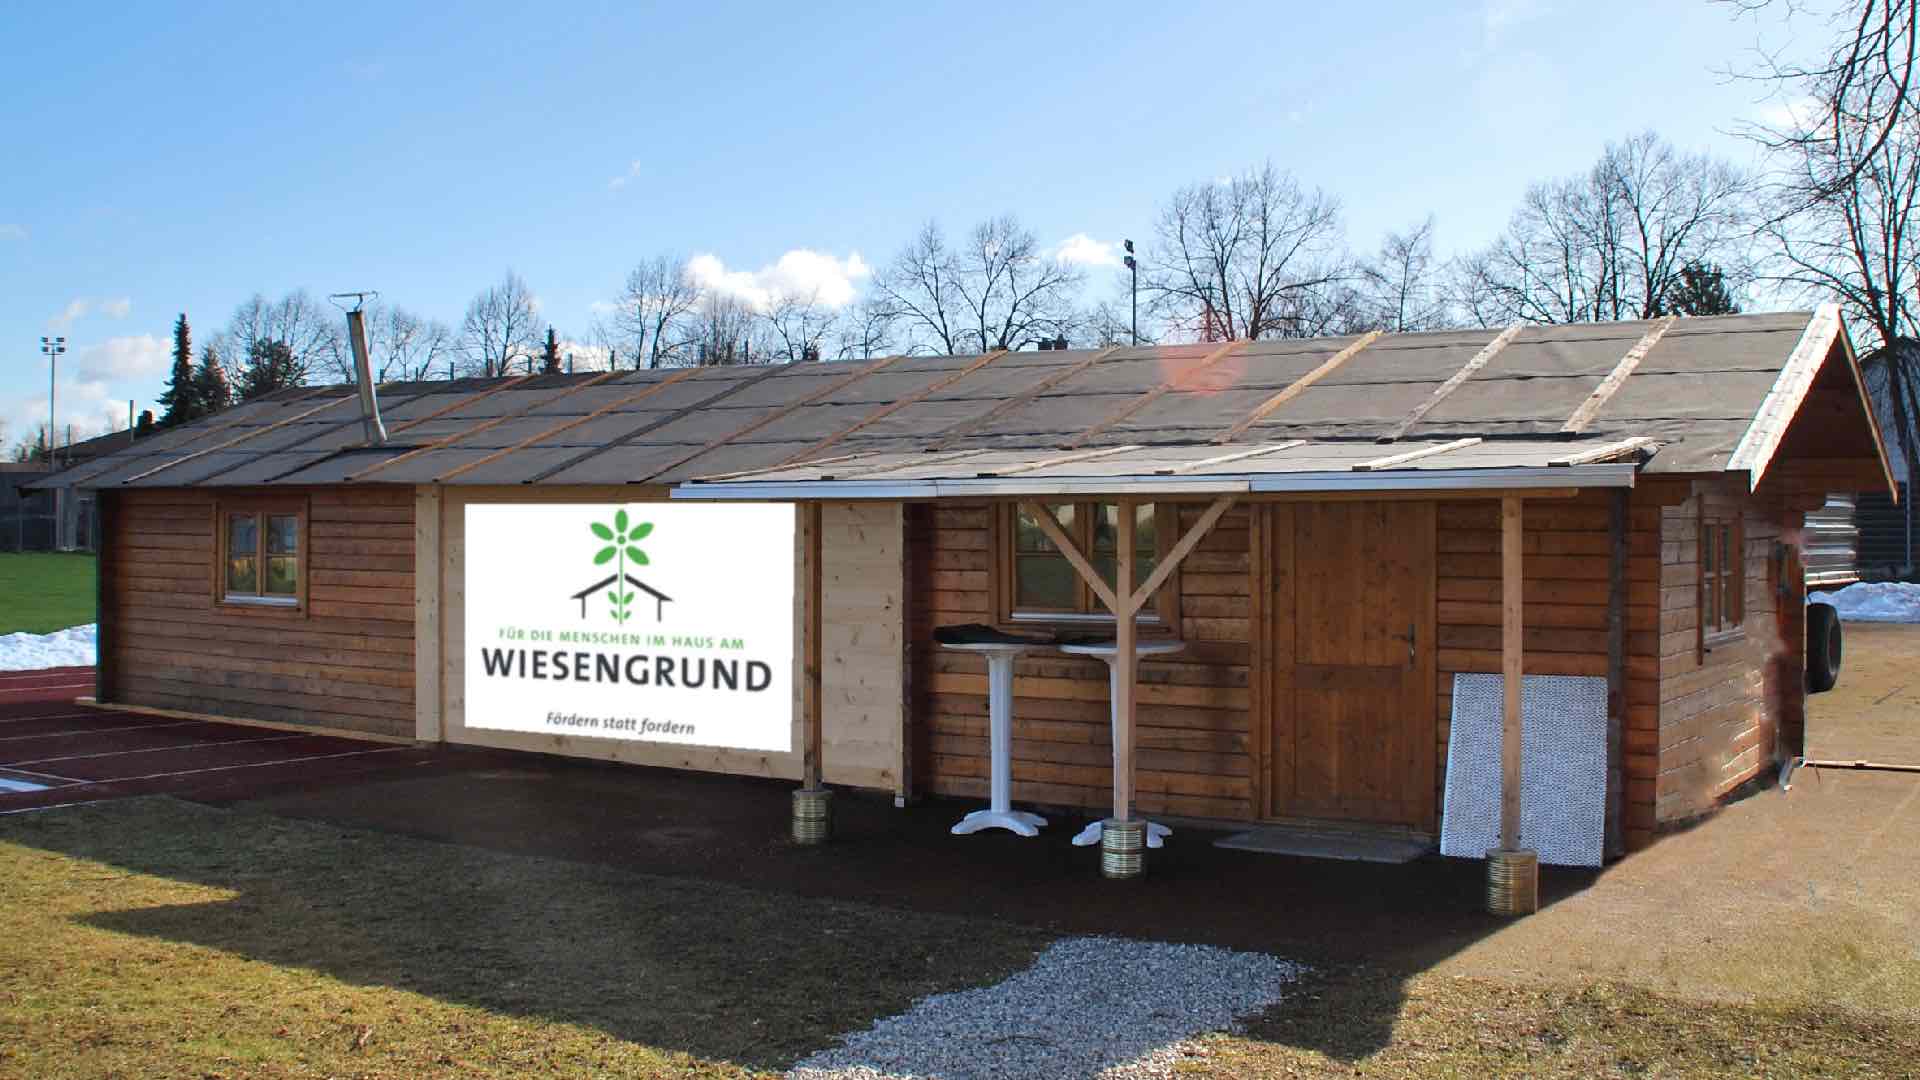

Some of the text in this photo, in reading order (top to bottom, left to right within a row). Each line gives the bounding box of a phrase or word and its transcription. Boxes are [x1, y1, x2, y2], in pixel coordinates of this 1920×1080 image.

[499, 626, 745, 650] FÜR DIE MENSCHEN IM HAUS AM
[481, 647, 772, 692] WIESENGRUND
[546, 711, 696, 735] Fördern statt fordern
